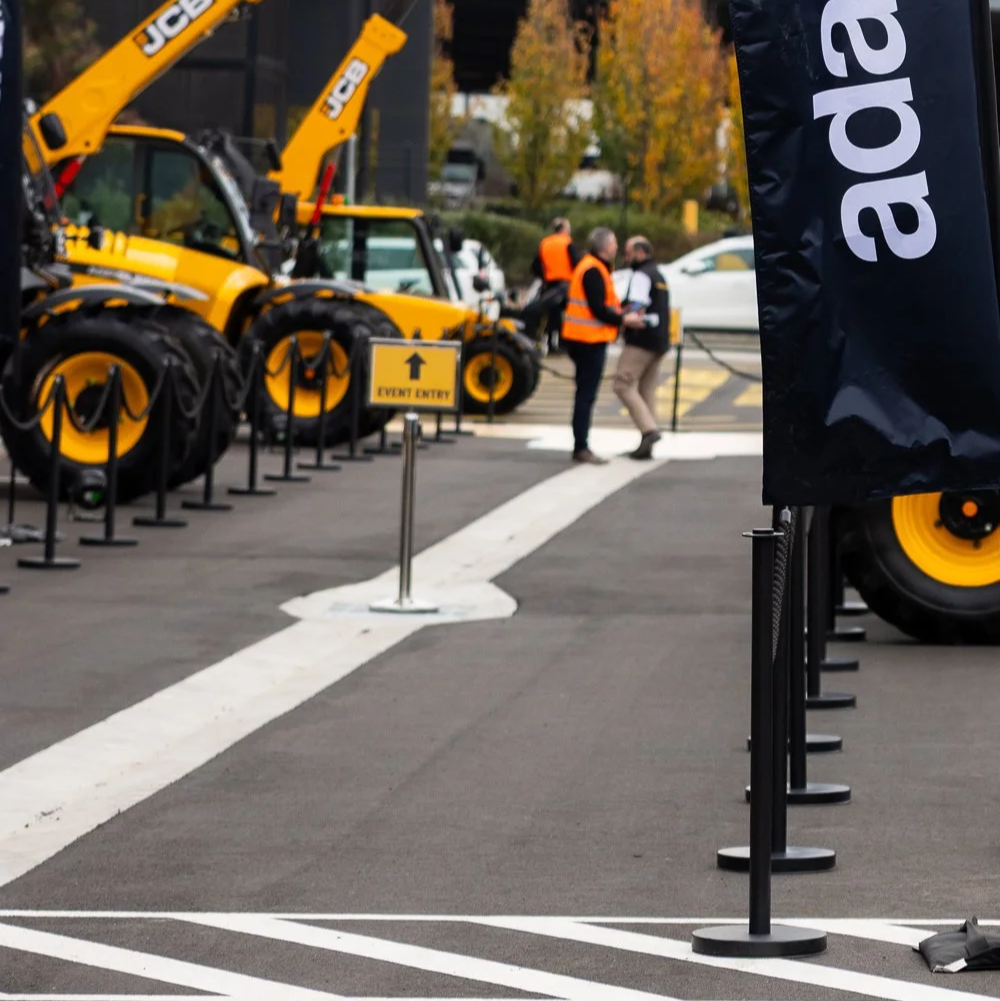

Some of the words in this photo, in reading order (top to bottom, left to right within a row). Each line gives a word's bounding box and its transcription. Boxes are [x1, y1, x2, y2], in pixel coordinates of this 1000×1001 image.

[325, 58, 369, 120] JCB
[377, 386, 412, 398] EVENT
[416, 388, 451, 401] ENTRY
